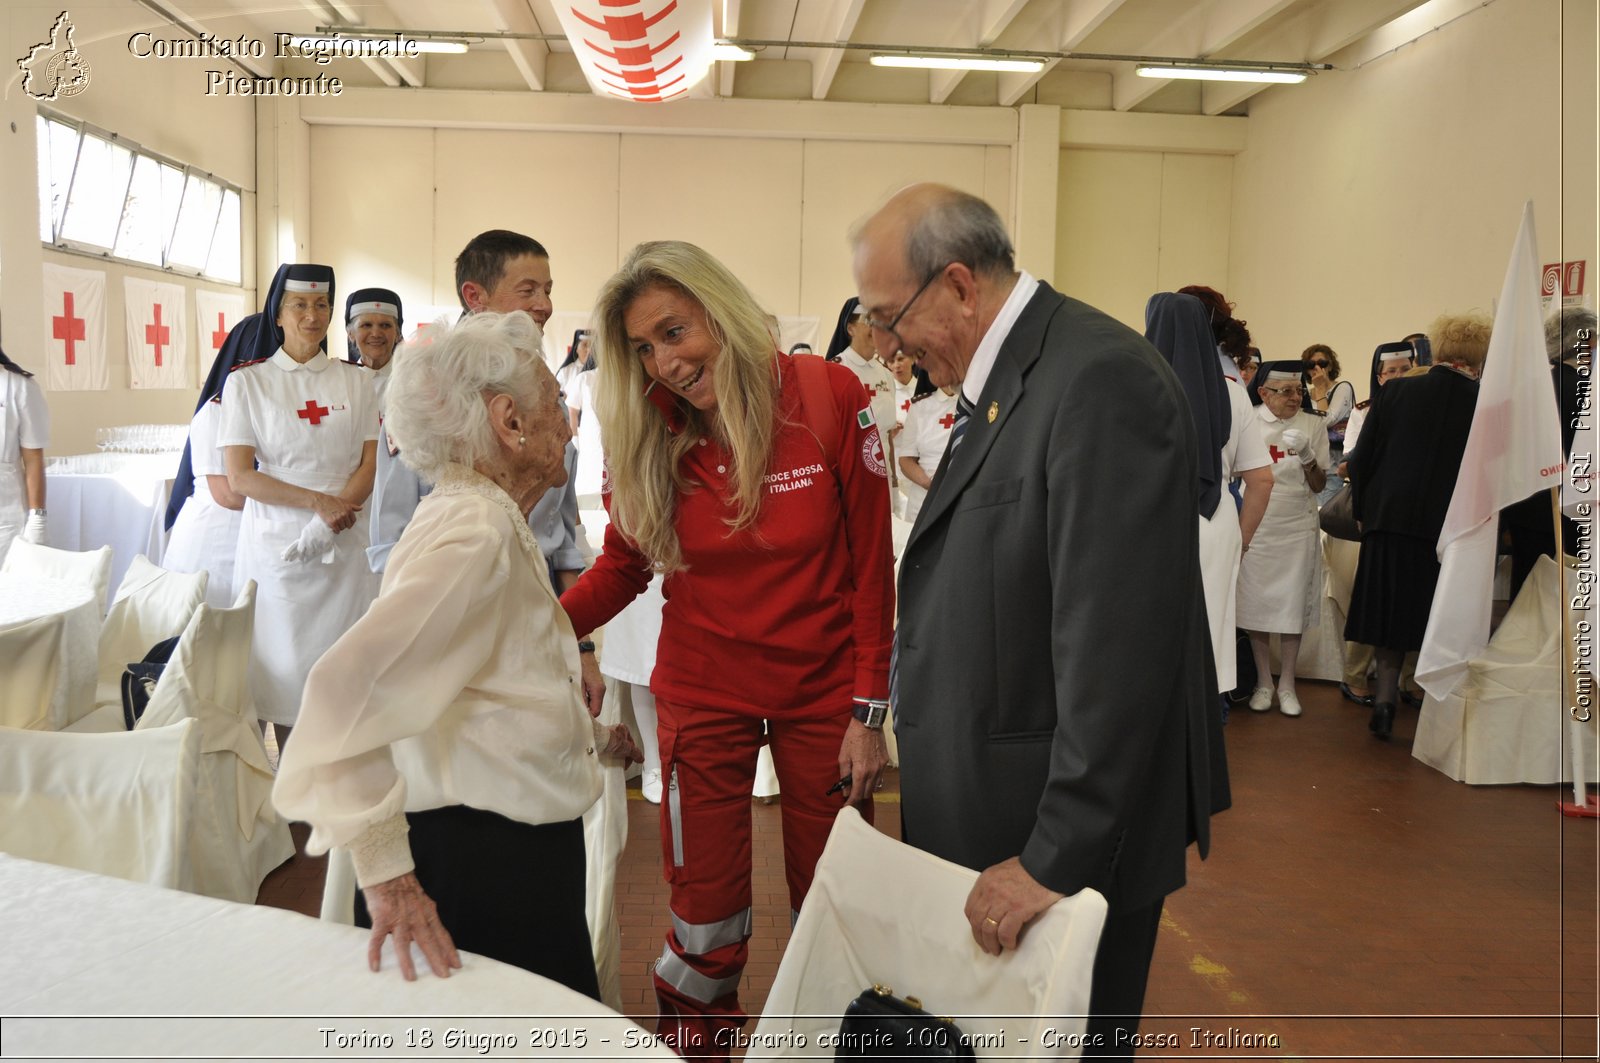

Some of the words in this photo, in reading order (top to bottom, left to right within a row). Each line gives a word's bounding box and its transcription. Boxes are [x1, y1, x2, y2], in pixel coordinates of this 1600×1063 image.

[763, 472, 790, 483] ROCE
[792, 464, 824, 478] ROSSA
[770, 478, 813, 494] ITALIANA
